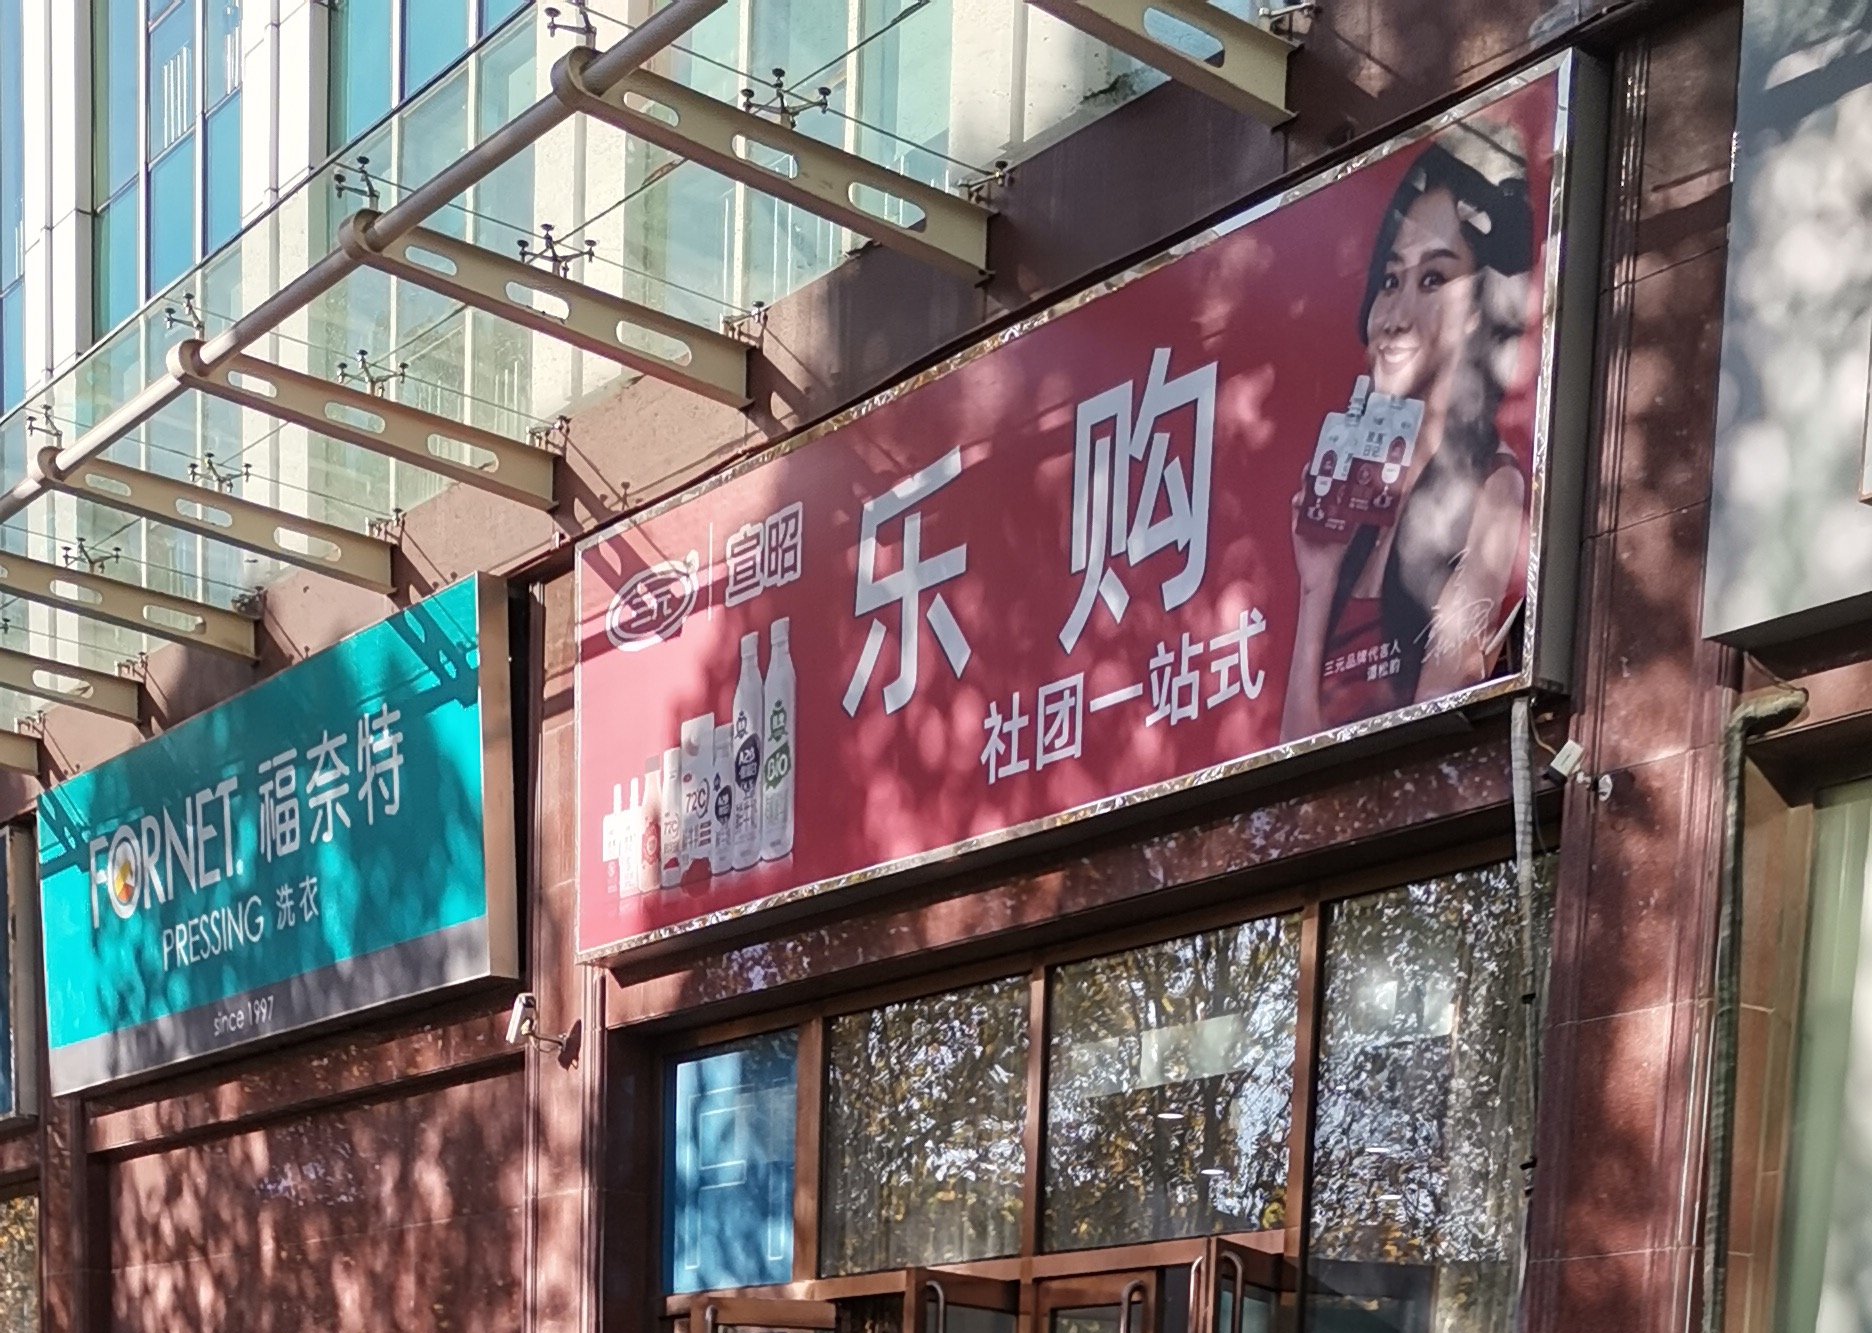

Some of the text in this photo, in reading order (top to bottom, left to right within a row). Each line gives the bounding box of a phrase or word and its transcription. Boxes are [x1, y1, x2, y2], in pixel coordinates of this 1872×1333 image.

[725, 502, 803, 607] 宣昭
[979, 608, 1267, 785] 社团一站式
[258, 703, 405, 864] 福奈特
[162, 875, 321, 972] PRESSING 洗衣
[213, 995, 275, 1037] since 1997
